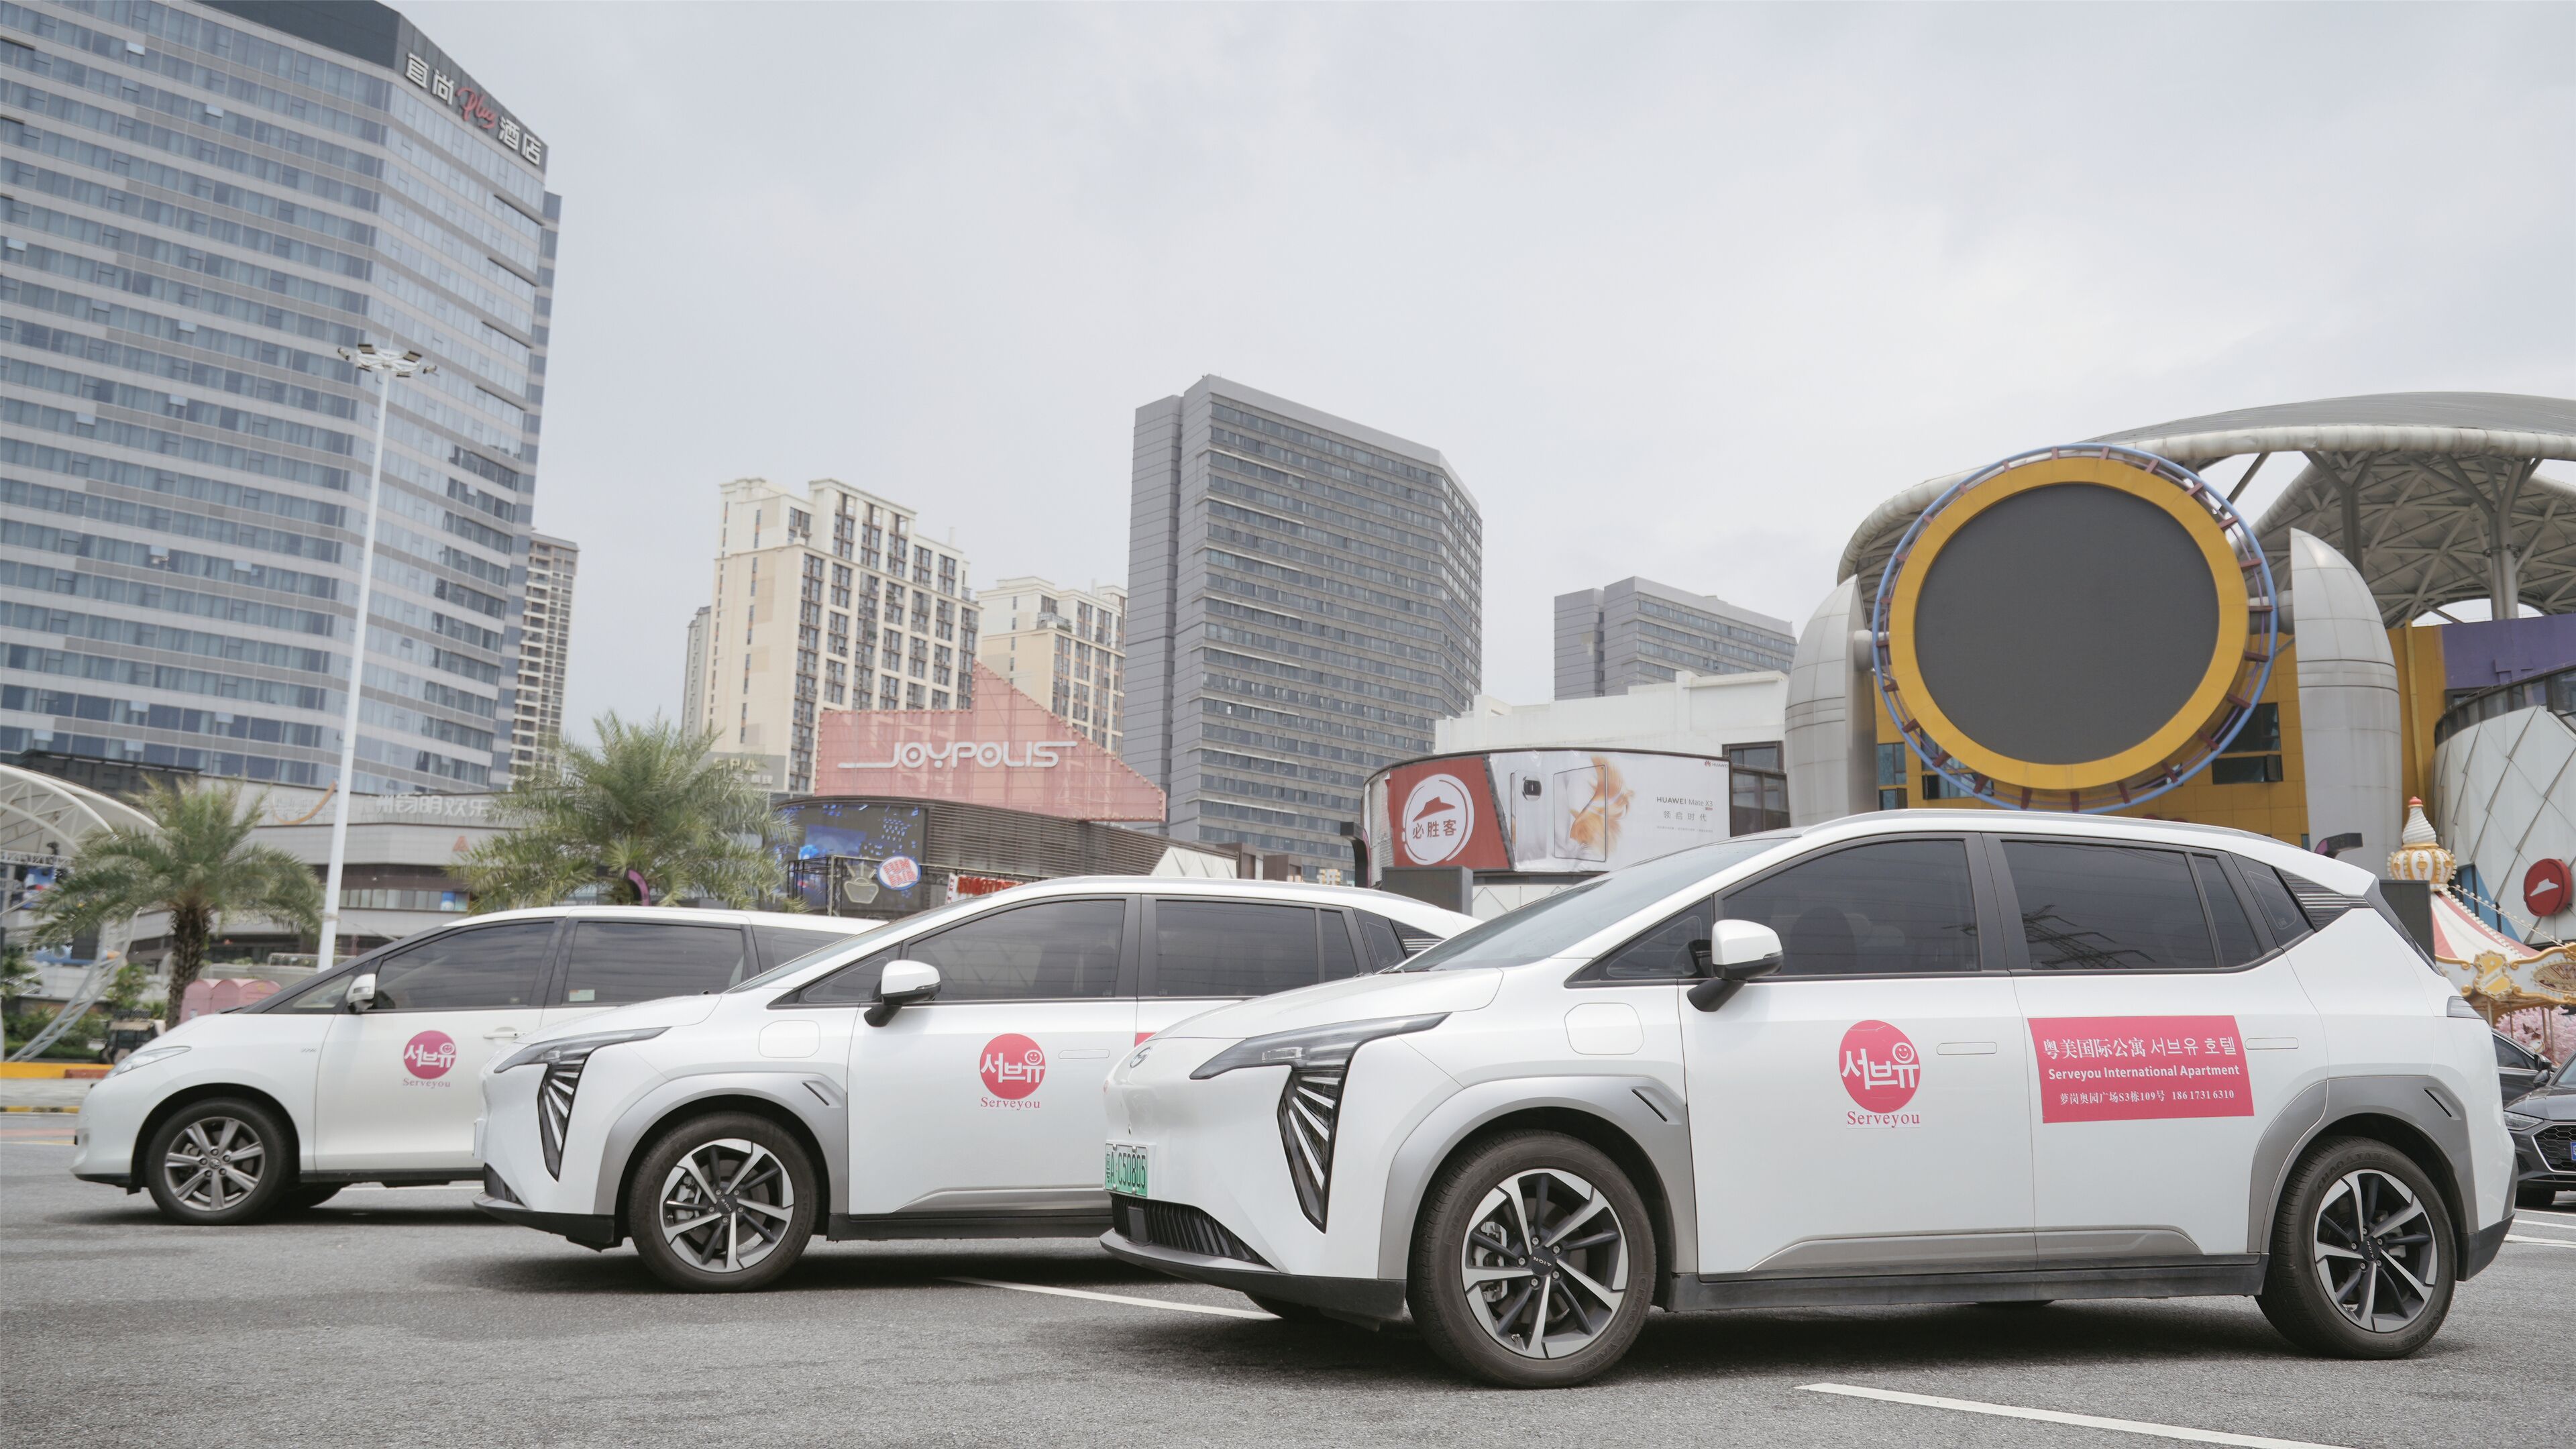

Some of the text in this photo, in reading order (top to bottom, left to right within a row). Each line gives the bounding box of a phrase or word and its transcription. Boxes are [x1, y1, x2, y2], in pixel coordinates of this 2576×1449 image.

[405, 52, 542, 166] 宜尚 Plus 酒店
[837, 741, 1078, 769] JOYPOLIS
[1656, 796, 1686, 805] HUAWEI
[1688, 798, 1704, 806] Mate
[1663, 810, 1707, 822] 领启时代
[1412, 819, 1456, 839] 必胜客
[403, 1042, 456, 1068] 서브유
[2043, 1036, 2237, 1060] 粤美国际公寓 서브유 호텔
[981, 1049, 1045, 1083] 서브유
[1841, 1042, 1920, 1090] 서브유
[2048, 1065, 2240, 1081] Serveyou International Apartment
[402, 1077, 451, 1089] Serveyou
[980, 1096, 1041, 1111] Serveyou
[2172, 1091, 2188, 1100] 186
[2190, 1090, 2211, 1099] 1731
[2212, 1089, 2235, 1099] 6310
[1847, 1111, 1921, 1128] Serveyou
[1118, 1152, 1146, 1189] C50805
[1533, 1256, 1552, 1267] AION
